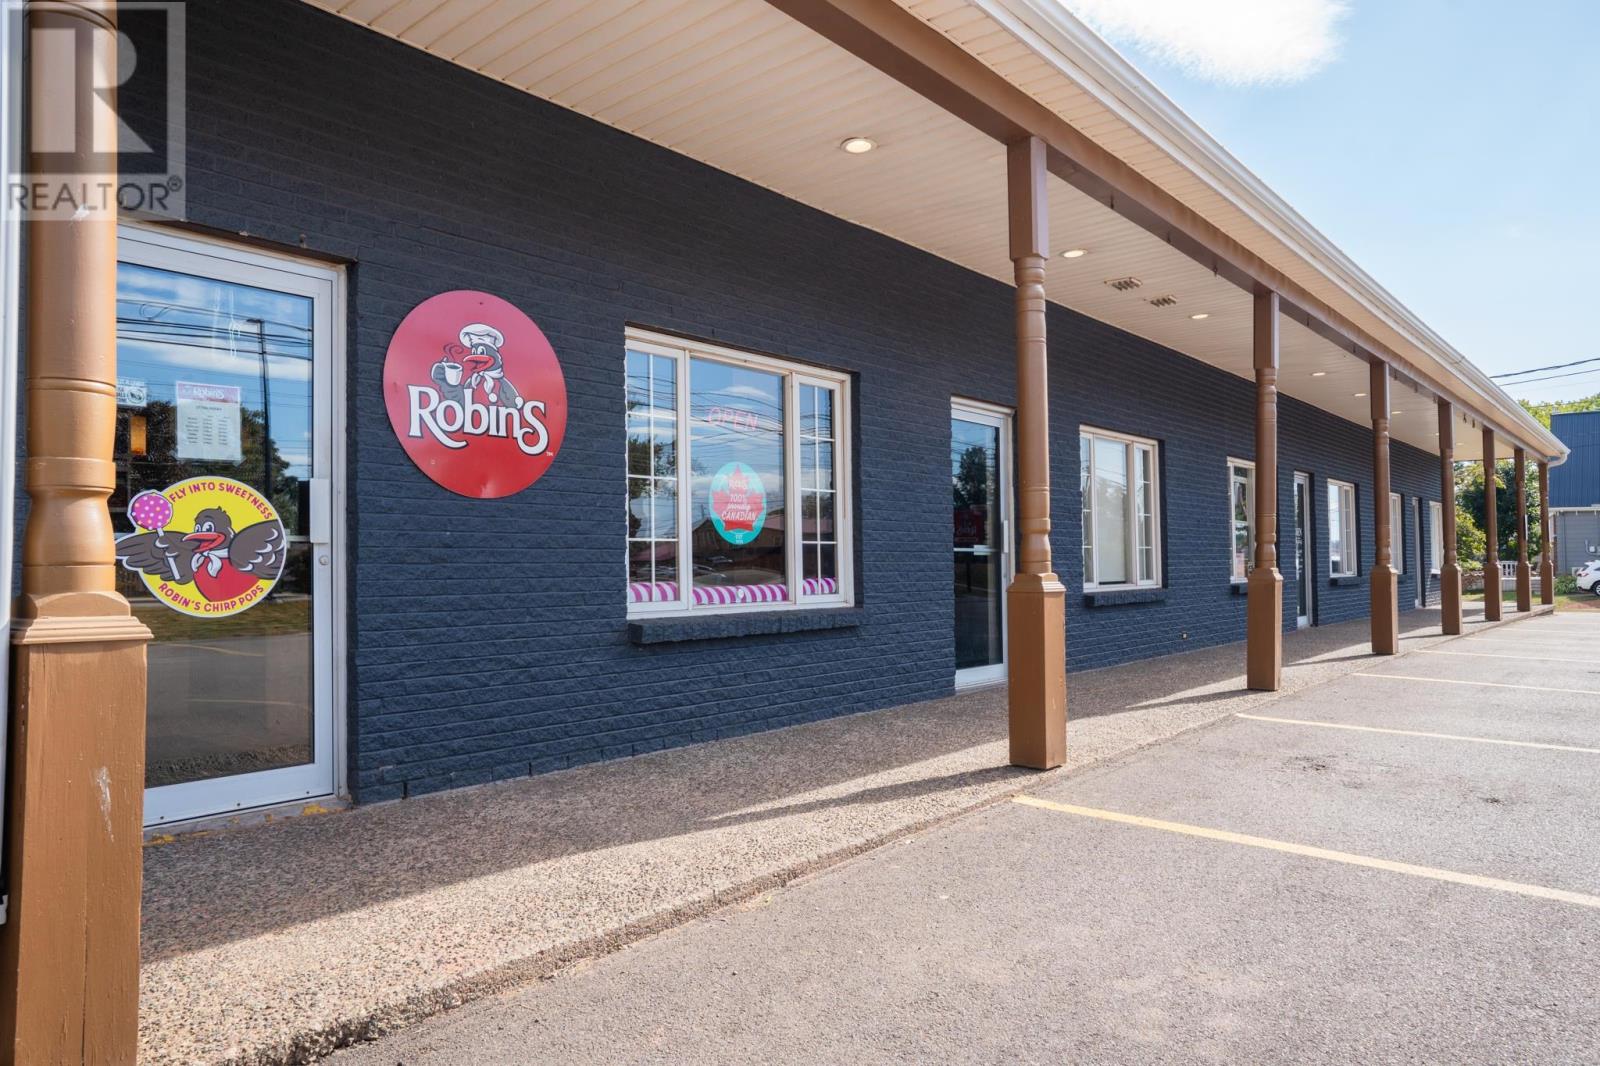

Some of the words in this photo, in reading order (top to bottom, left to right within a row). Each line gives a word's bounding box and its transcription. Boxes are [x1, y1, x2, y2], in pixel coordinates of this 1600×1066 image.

[706, 406, 759, 432] OPEN
[169, 487, 187, 503] FLY
[188, 481, 216, 494] INTO
[218, 482, 273, 520] SWEETNESS
[158, 582, 202, 611] ROBIN'S
[203, 600, 237, 612] CHIRP
[238, 584, 265, 606] POPS
